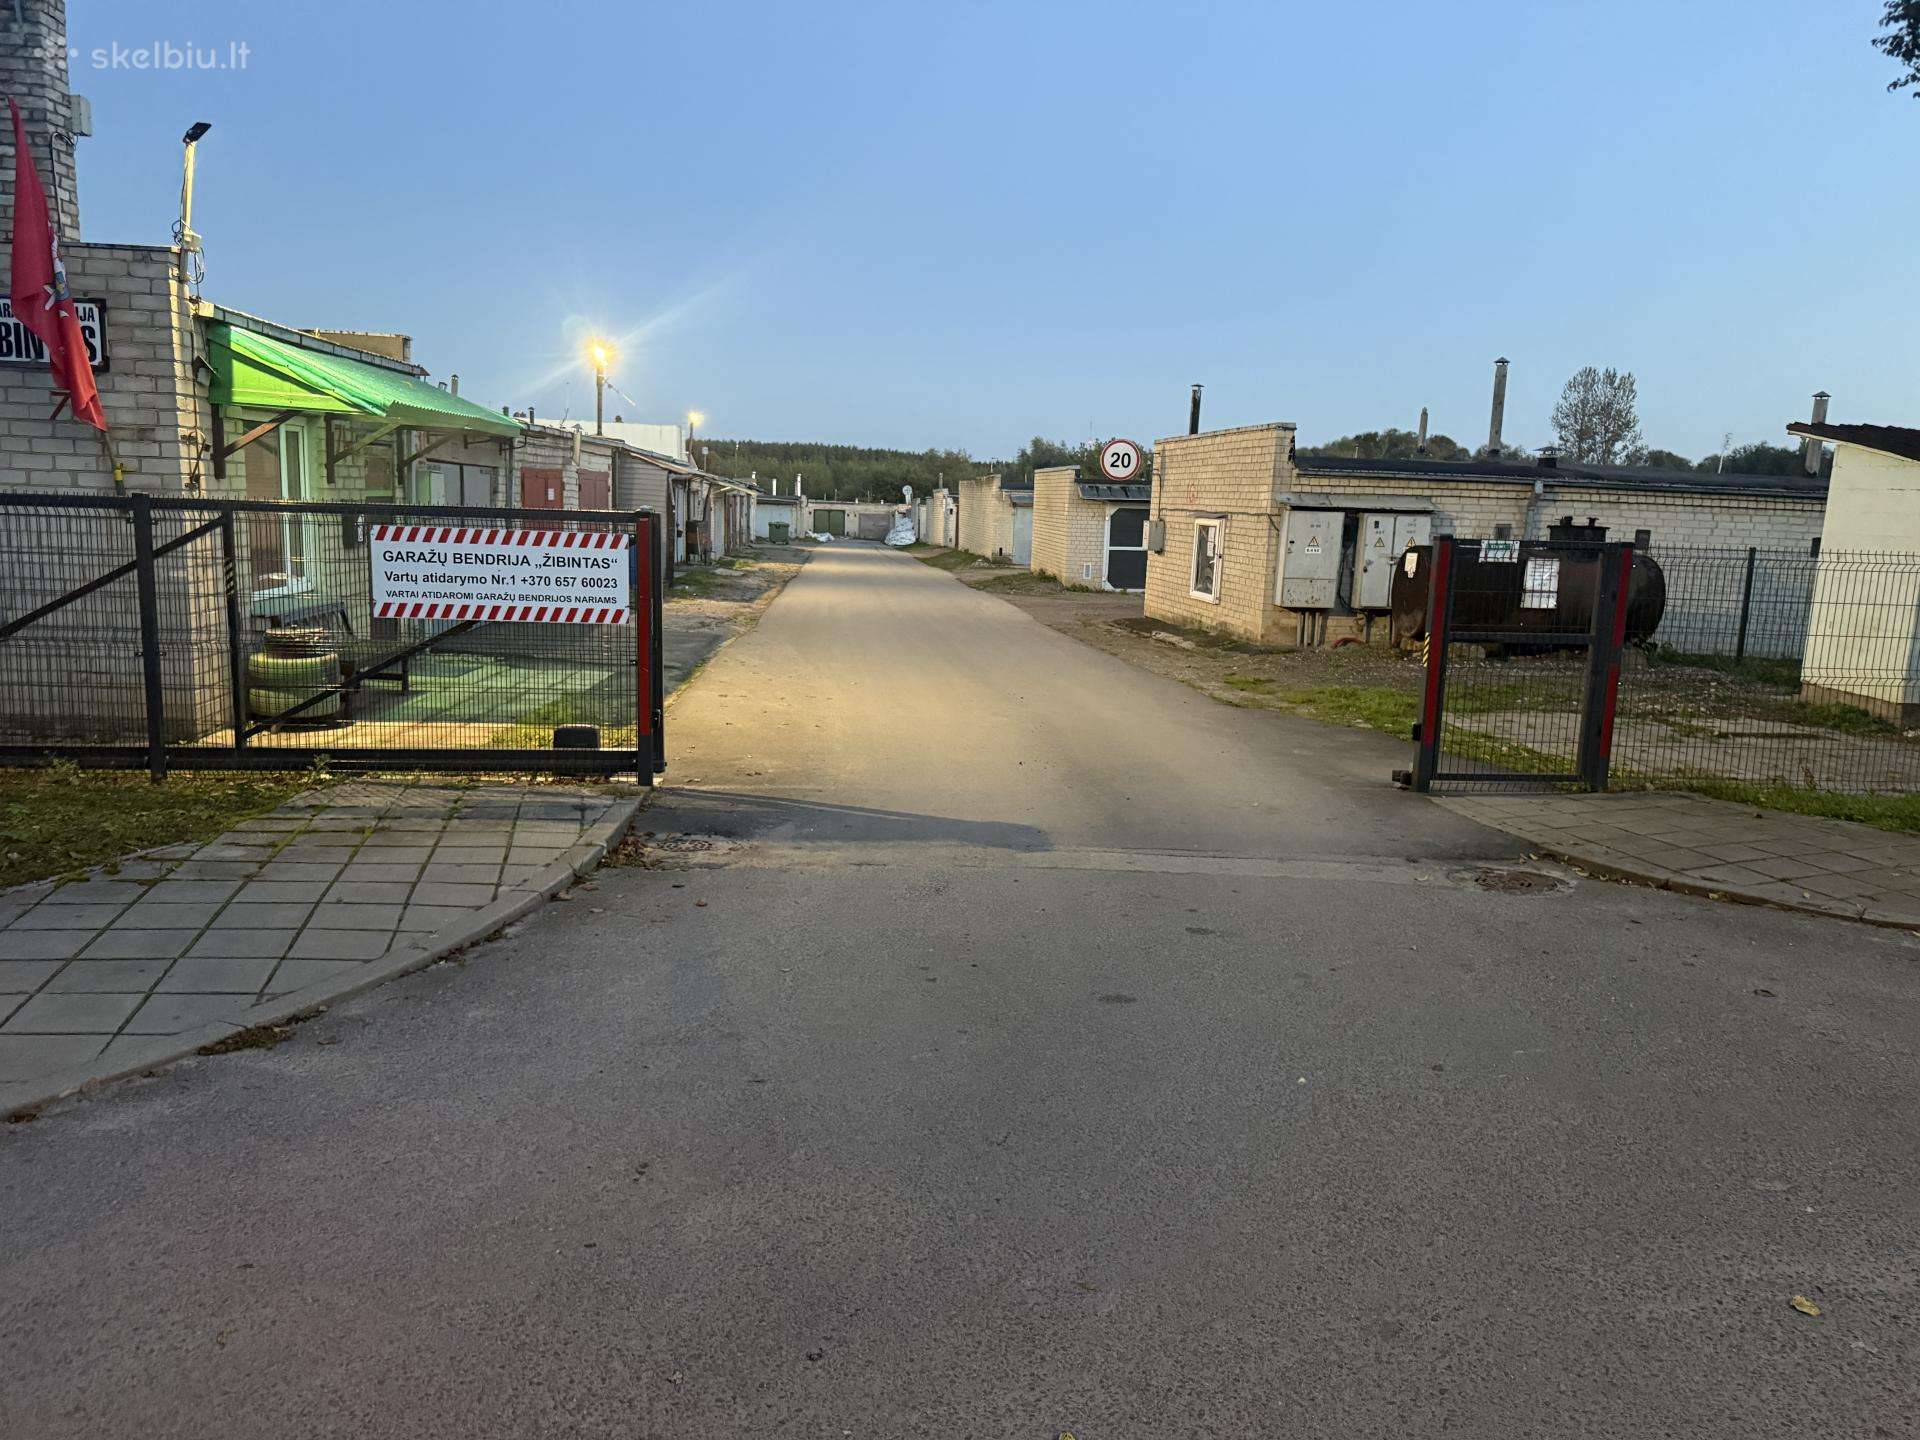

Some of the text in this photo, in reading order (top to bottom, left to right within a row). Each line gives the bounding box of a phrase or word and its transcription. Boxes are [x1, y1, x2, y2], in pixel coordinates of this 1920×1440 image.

[1110, 452, 1131, 468] 20
[383, 549, 447, 566] GARAŽŲ
[453, 552, 531, 567] BENDRIJA
[384, 571, 618, 589] Vartų atidarymo Nr.1 +370 657 60023
[386, 590, 617, 604] VARTAI ATIDAROMI GARAŽŲ BENDRIJOS NARIAMS
